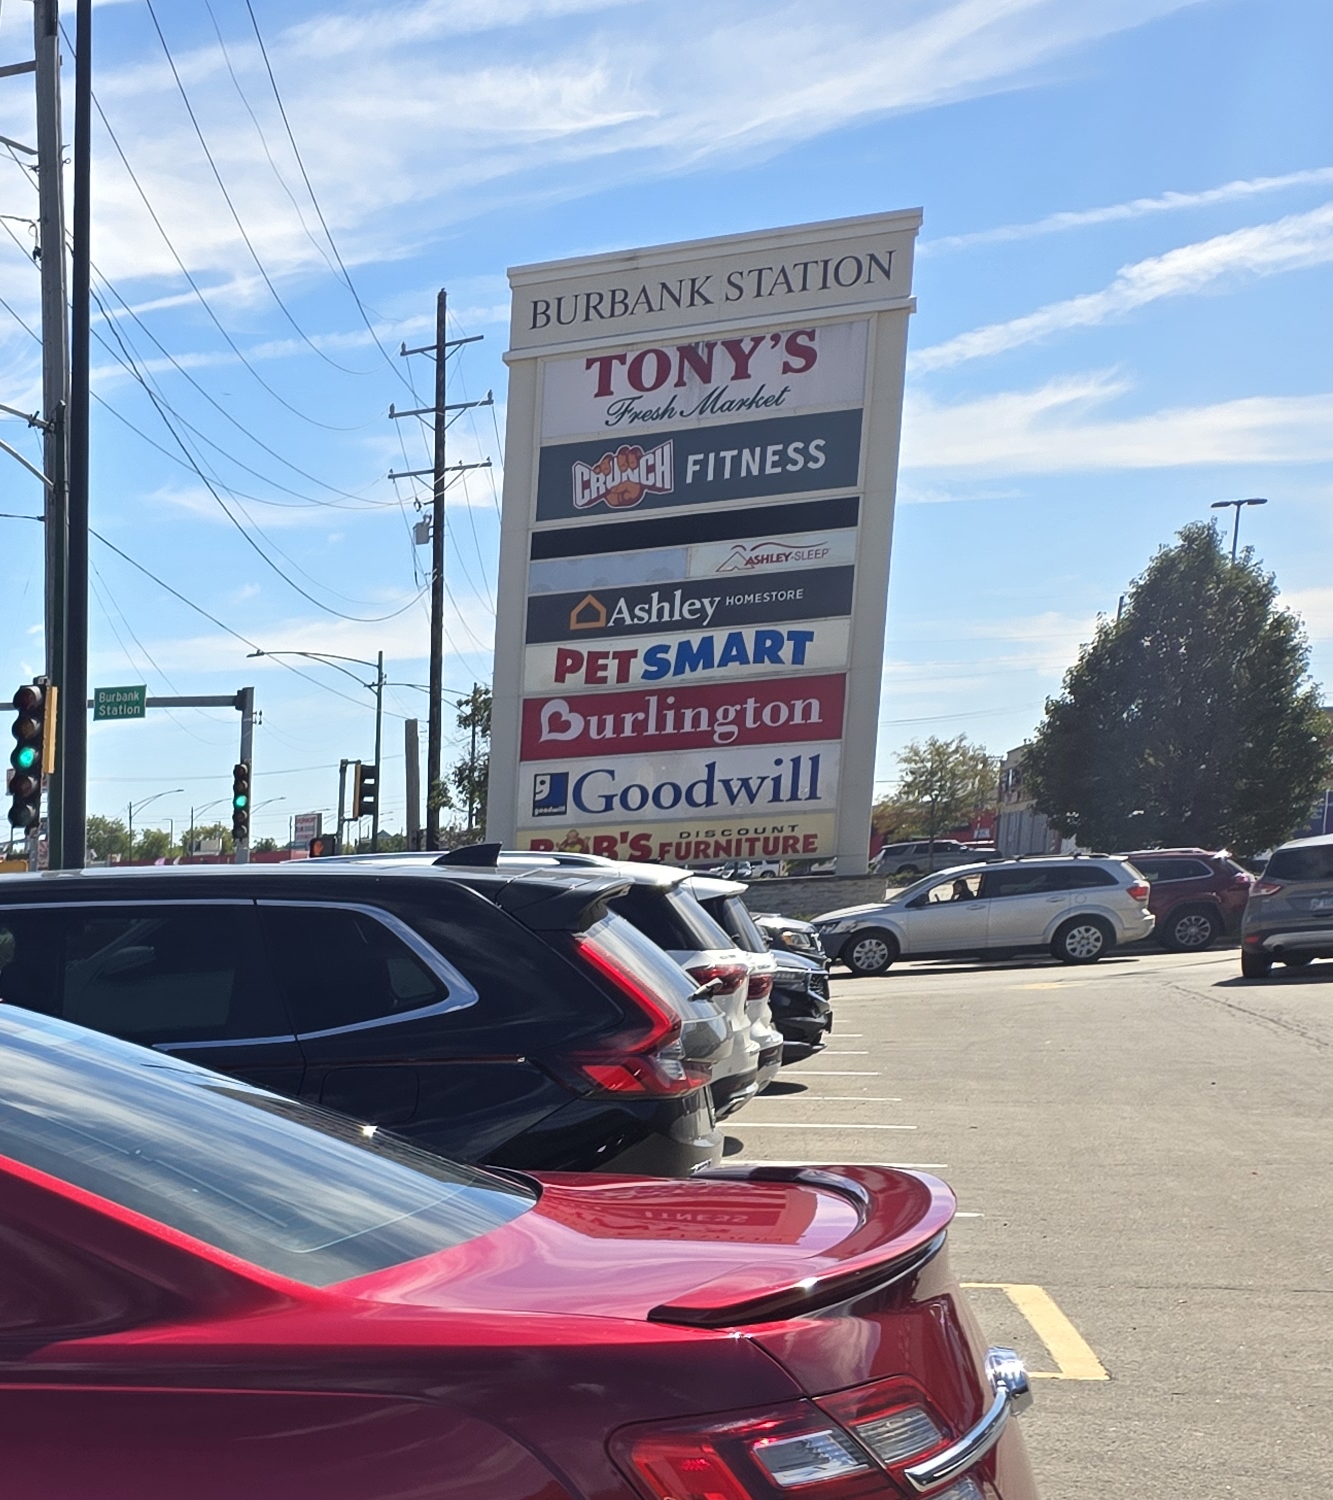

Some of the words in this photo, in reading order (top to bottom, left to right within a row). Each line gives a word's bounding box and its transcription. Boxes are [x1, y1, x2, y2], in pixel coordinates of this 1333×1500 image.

[529, 274, 714, 330] BURBANK
[725, 250, 896, 302] STATION
[585, 329, 817, 398] TONY'S
[605, 395, 676, 427] Fresh
[680, 383, 791, 419] Market
[574, 440, 673, 508] CRUNCH
[686, 439, 826, 484] FITNESS
[607, 589, 720, 627] Ashley
[726, 588, 804, 606] HOMESTORE
[554, 629, 814, 685] PETSMART
[99, 691, 140, 703] Burbank
[99, 704, 140, 716] Station
[539, 696, 822, 744] Burlington
[572, 754, 821, 814] Goodwill
[658, 833, 818, 861] FURNITURE
[679, 824, 799, 839] DISCOUNT
